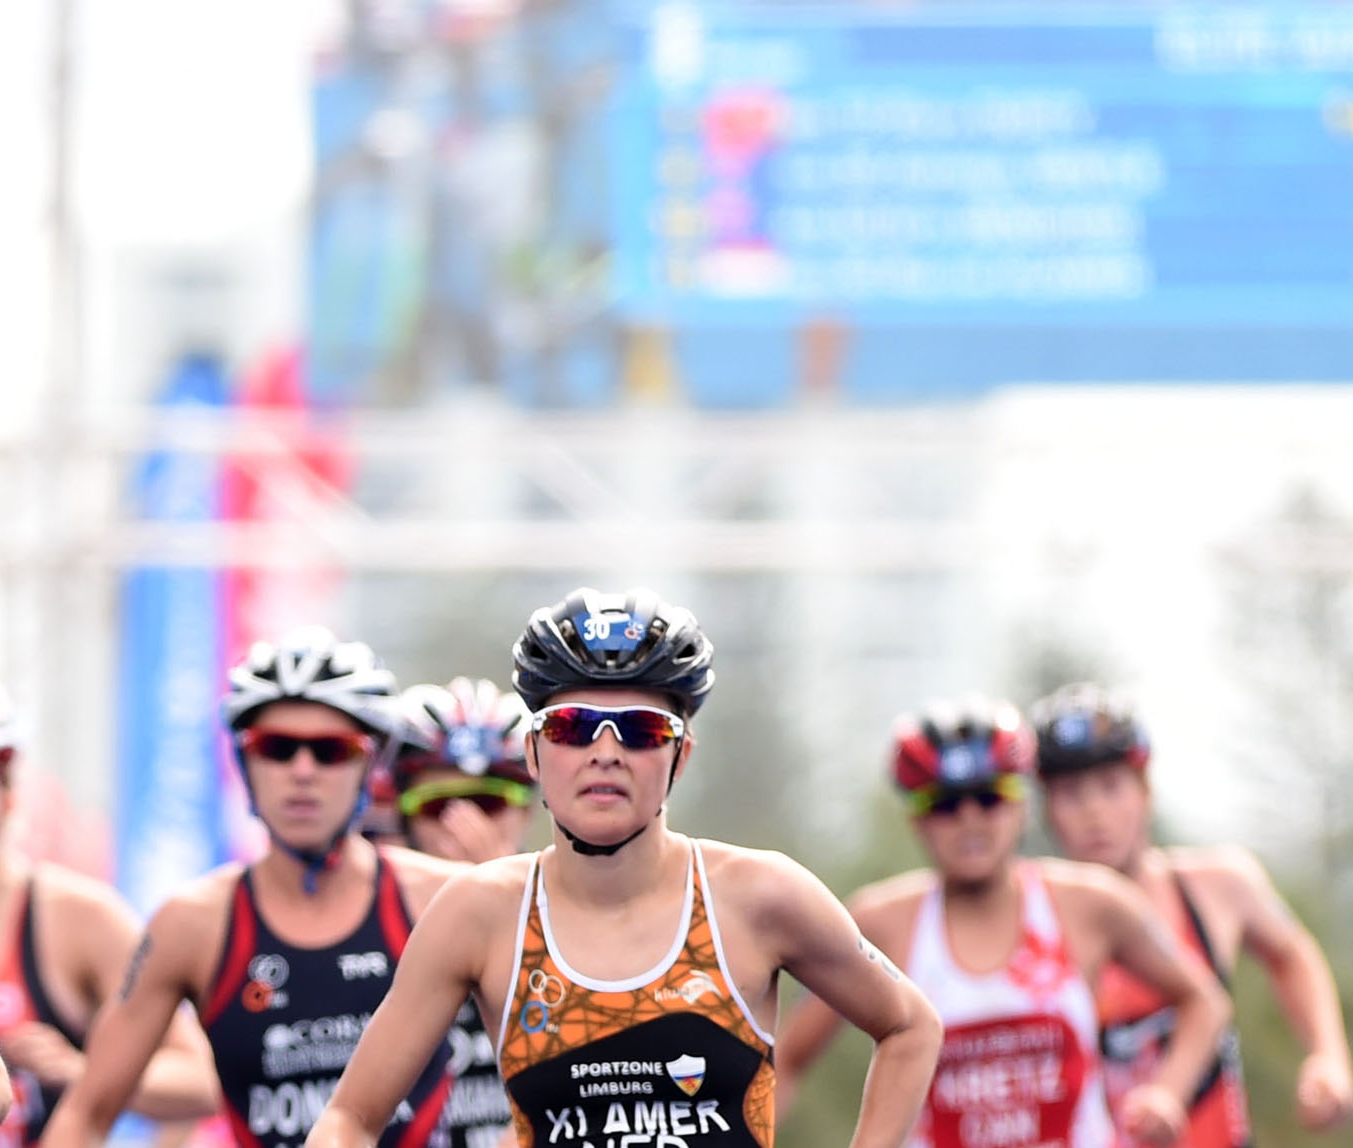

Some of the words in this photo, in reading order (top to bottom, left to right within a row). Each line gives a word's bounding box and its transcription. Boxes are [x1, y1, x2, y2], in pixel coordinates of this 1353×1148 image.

[584, 618, 610, 641] 30
[570, 1061, 664, 1079] SPORTZONE
[579, 1081, 654, 1098] LIMBURG
